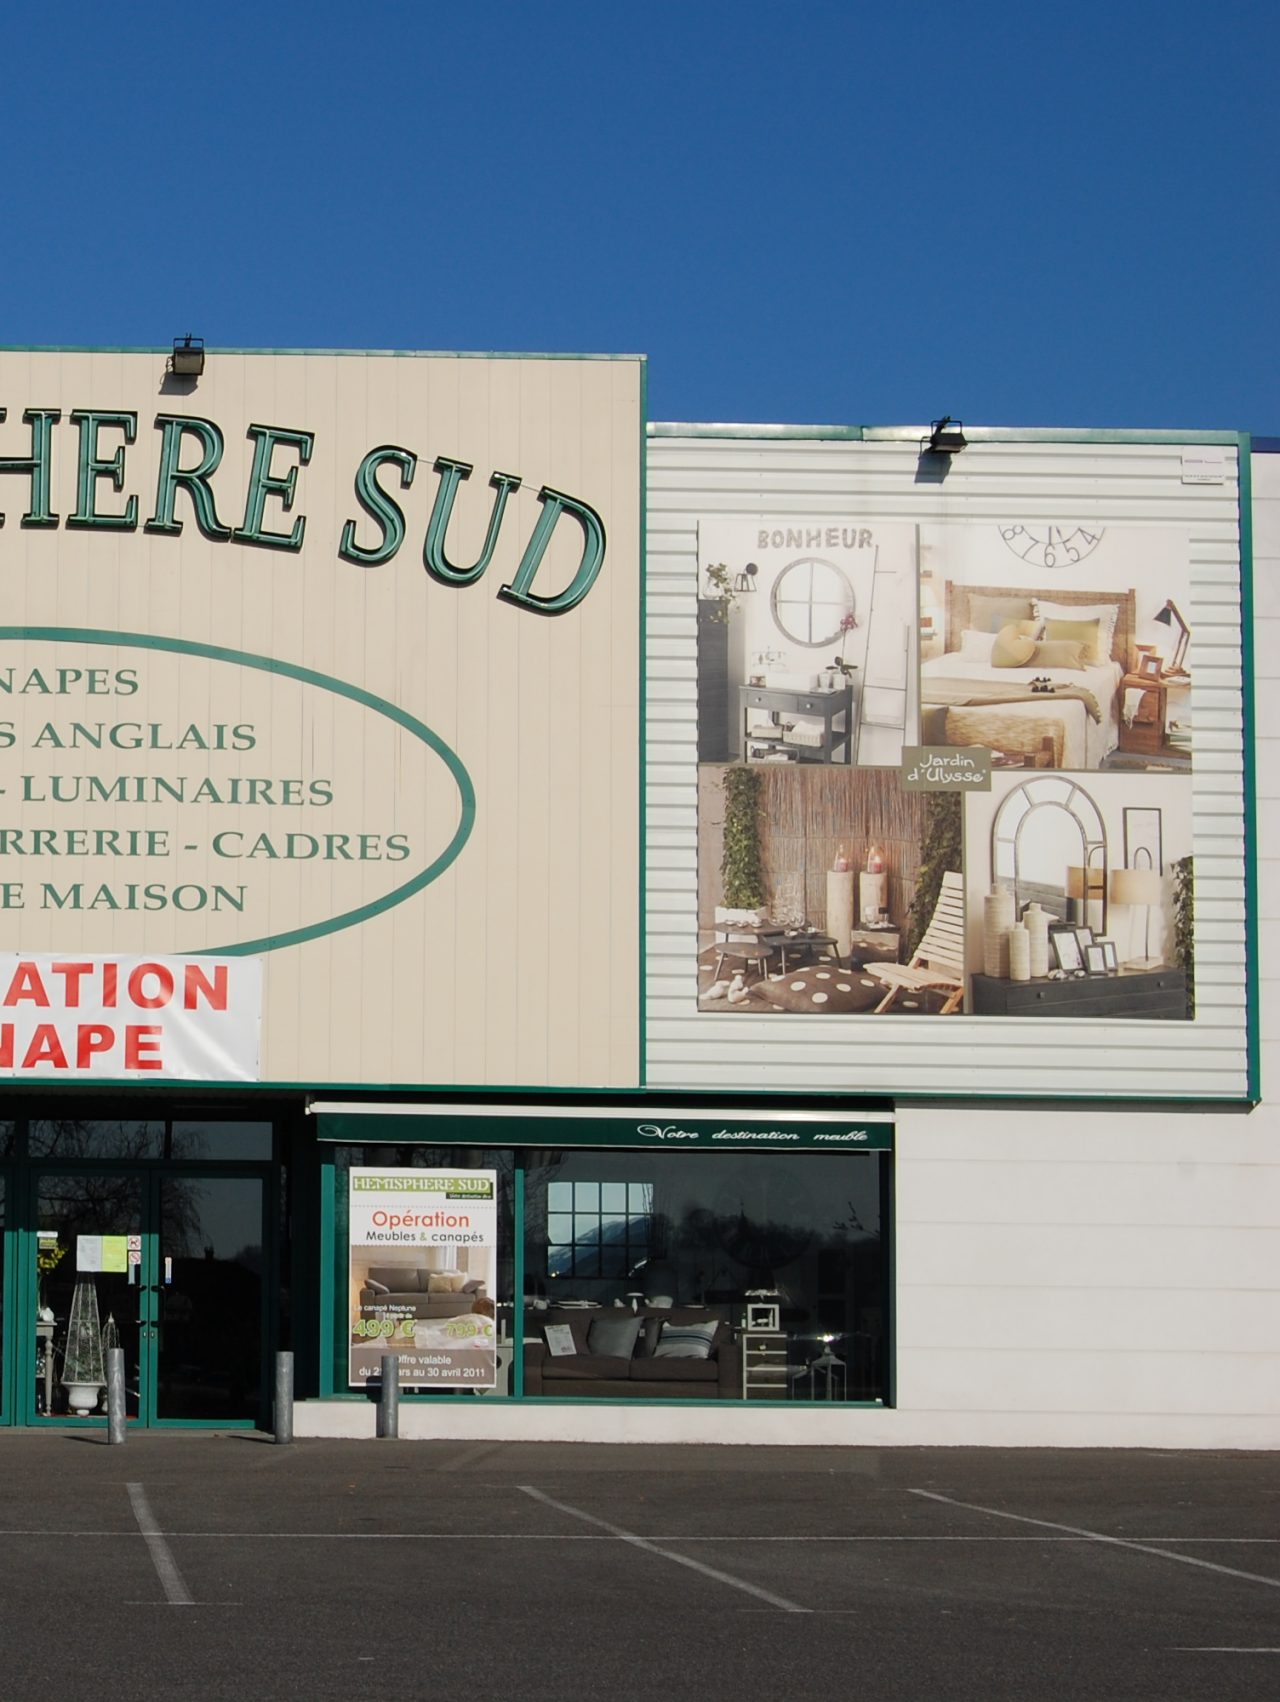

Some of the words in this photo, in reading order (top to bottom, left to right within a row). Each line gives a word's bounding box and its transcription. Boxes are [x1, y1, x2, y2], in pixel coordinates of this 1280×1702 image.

[338, 445, 606, 617] SUD
[757, 527, 873, 549] BONHEUR
[32, 722, 257, 751] ANGLAIS
[919, 753, 975, 768] Jardin
[19, 775, 334, 806] LUMINAIRES
[212, 831, 410, 861] CADRES
[40, 883, 248, 911] MAISON
[637, 1124, 699, 1140] Votre
[712, 1129, 799, 1141] destination
[813, 1130, 868, 1142] meuble
[354, 1177, 455, 1190] HEMISPHERE
[458, 1179, 489, 1191] SUD
[372, 1209, 469, 1230] Opération
[365, 1231, 416, 1241] Meubles
[431, 1231, 484, 1243] canapés
[352, 1319, 395, 1338] 499
[398, 1354, 417, 1365] ffre
[418, 1355, 452, 1366] valable
[358, 1367, 371, 1376] du
[413, 1368, 425, 1377] au
[427, 1367, 440, 1377] 30
[441, 1367, 461, 1377] avril
[462, 1367, 485, 1378] 2011
